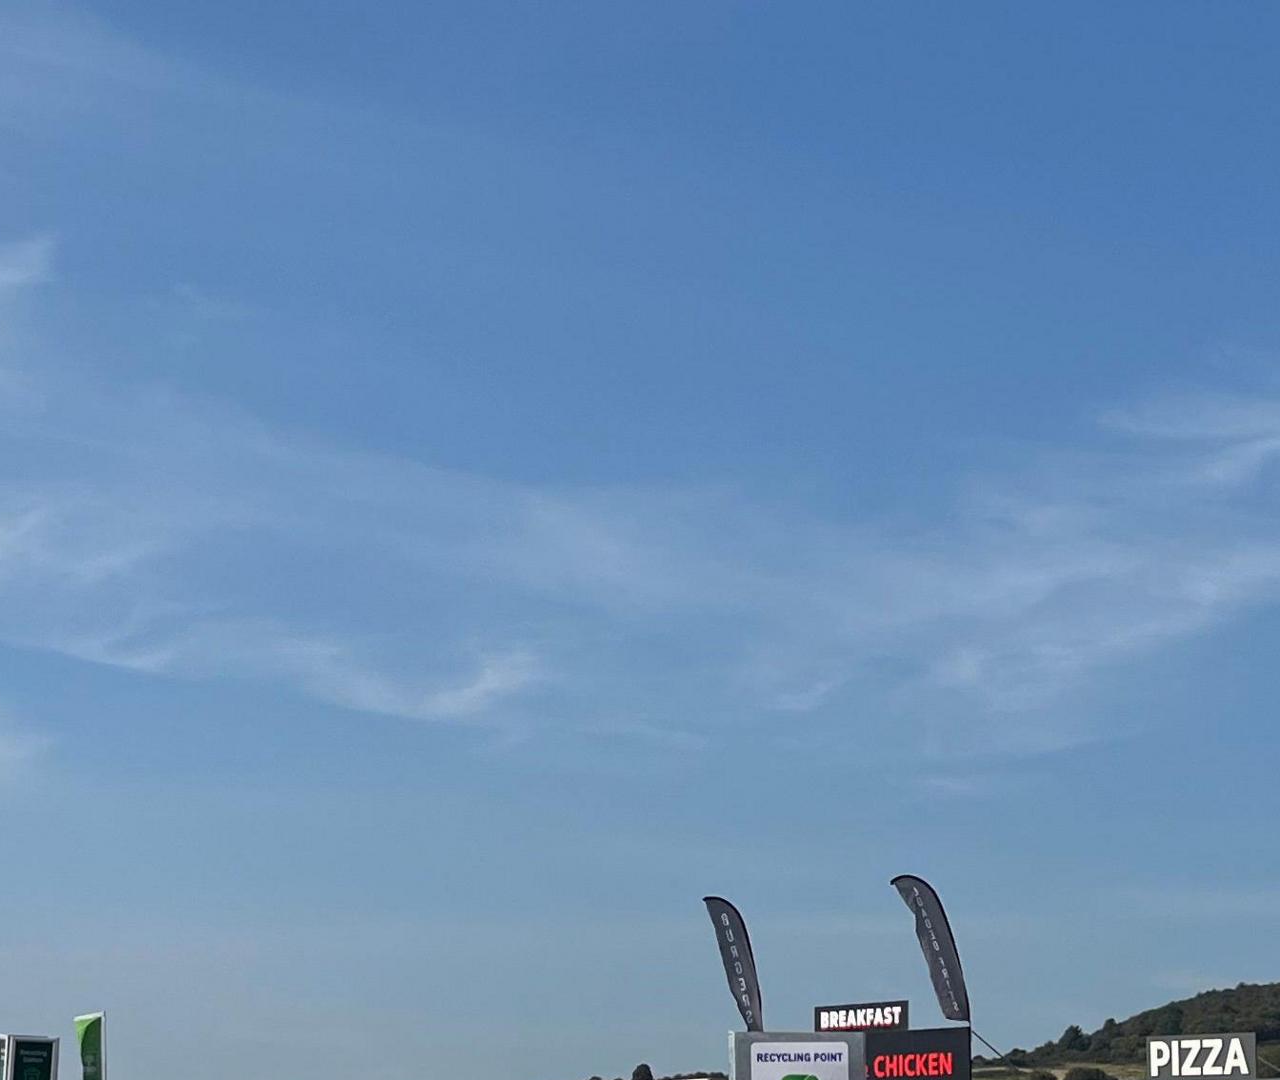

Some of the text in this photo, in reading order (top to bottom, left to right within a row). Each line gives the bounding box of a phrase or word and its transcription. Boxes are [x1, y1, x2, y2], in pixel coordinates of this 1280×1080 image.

[820, 1006, 902, 1029] BREAKFAST
[756, 1052, 843, 1063] RECYCLING POINT
[873, 1052, 953, 1078] CHICKEN
[1149, 1037, 1249, 1077] PIZZA
